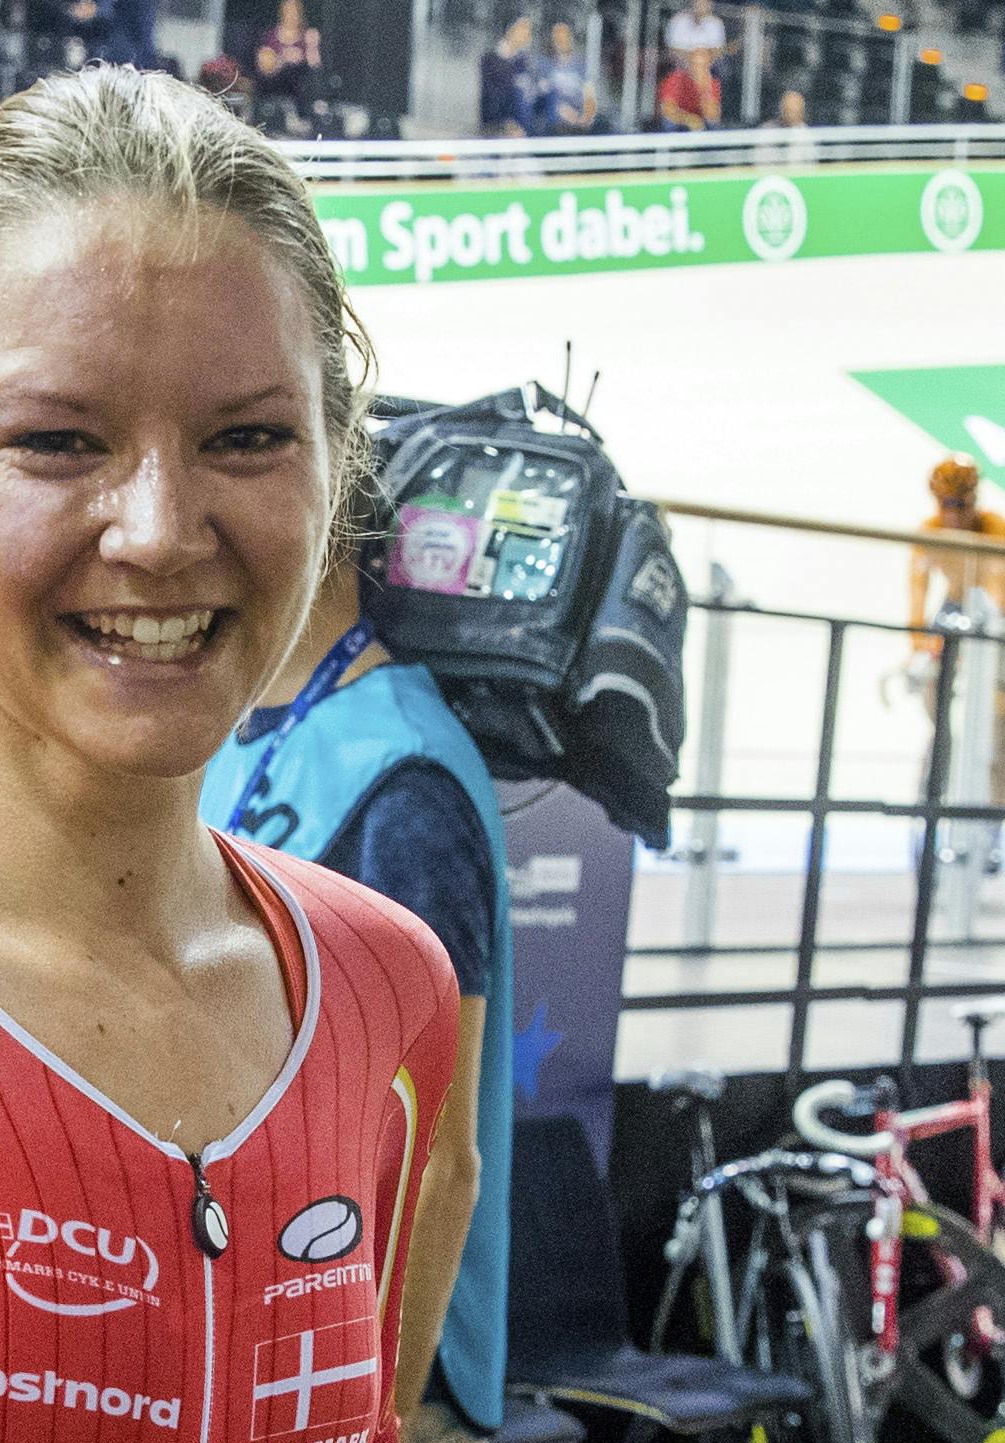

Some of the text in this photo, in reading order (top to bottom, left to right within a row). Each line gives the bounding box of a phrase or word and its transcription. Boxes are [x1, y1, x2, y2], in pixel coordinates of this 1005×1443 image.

[380, 201, 533, 284] Sport
[541, 187, 705, 263] dabei.
[16, 1208, 137, 1266] DCU
